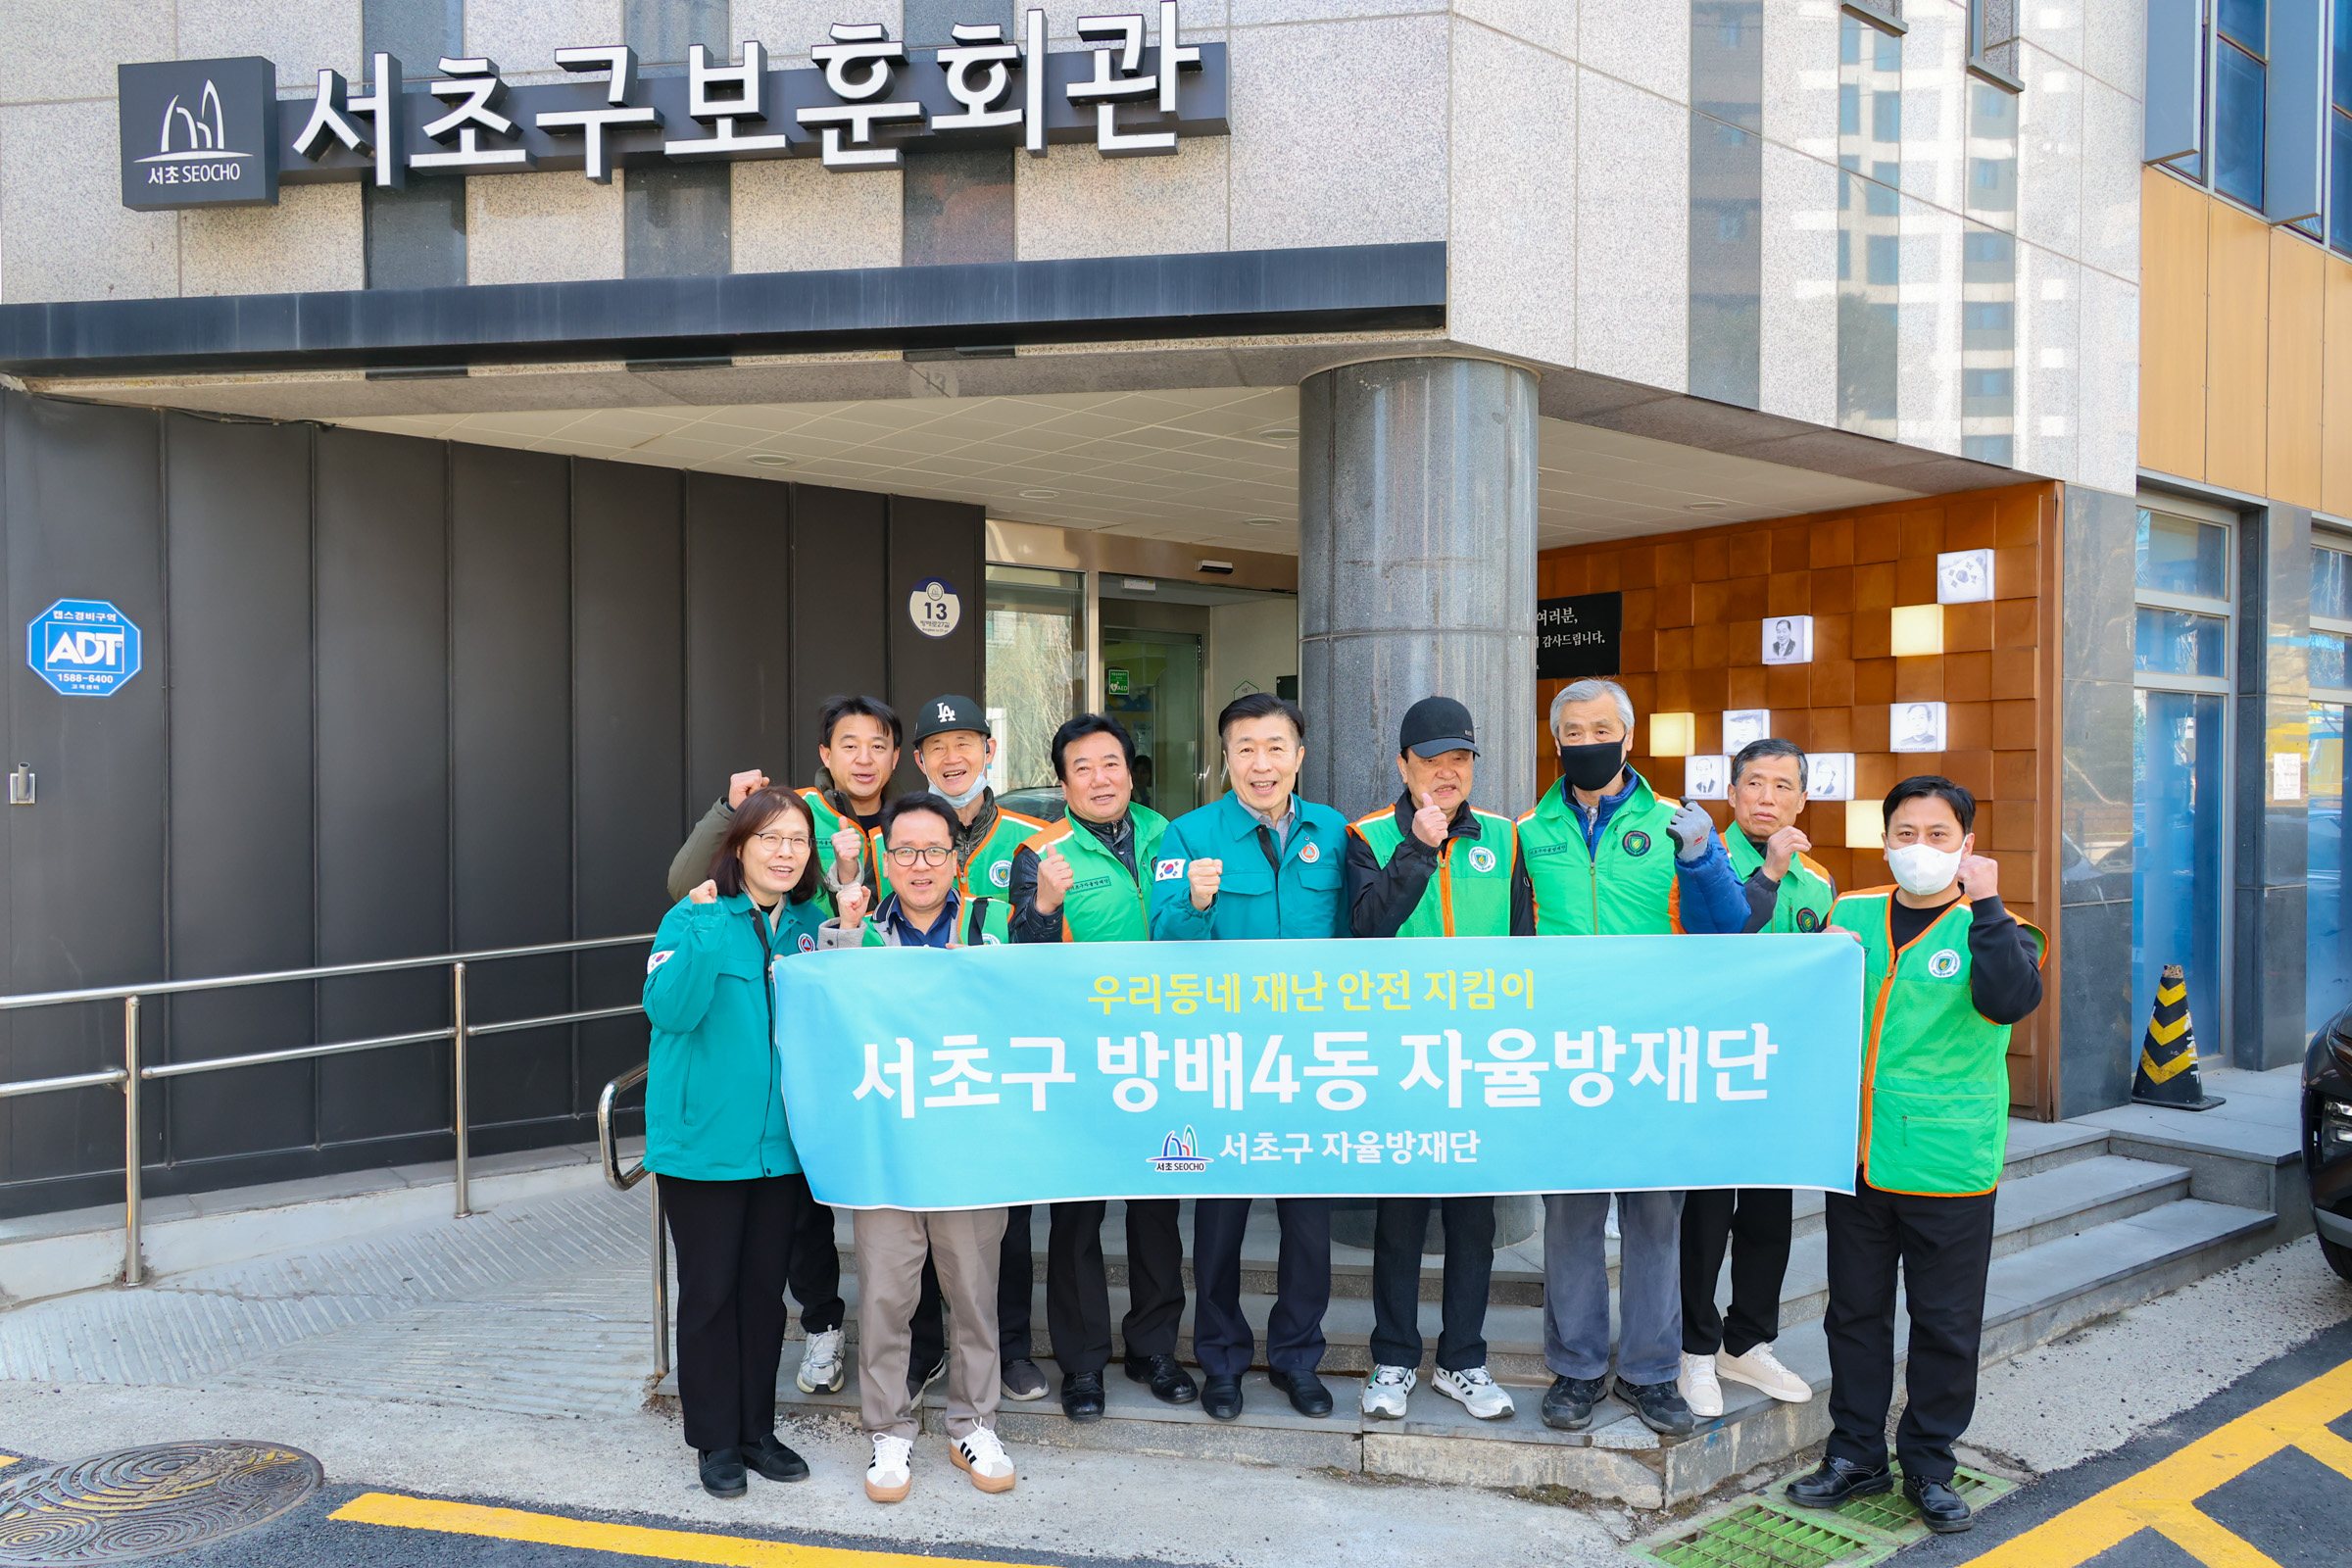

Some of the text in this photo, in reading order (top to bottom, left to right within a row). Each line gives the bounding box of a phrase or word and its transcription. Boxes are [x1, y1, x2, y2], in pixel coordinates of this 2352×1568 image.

[293, 0, 1202, 186] 서초구보훈회관
[148, 163, 240, 184] 서초 SEOCHO
[53, 610, 117, 621] 캡스경비구역
[924, 602, 948, 619] 13
[1537, 608, 1578, 625] 여러분,
[47, 631, 122, 665] ADT
[1543, 630, 1605, 648] 감사드립니다.
[57, 673, 114, 684] 1588-6400
[937, 702, 956, 722] LA
[1088, 968, 1535, 1015] 우리동네 재난 안전 지킴이
[852, 1022, 1779, 1119] 서초구 방배4동 자율방재단
[1219, 1129, 1482, 1165] 서초구 자율방재단
[1156, 1162, 1204, 1171] 서초 SEOCHO
